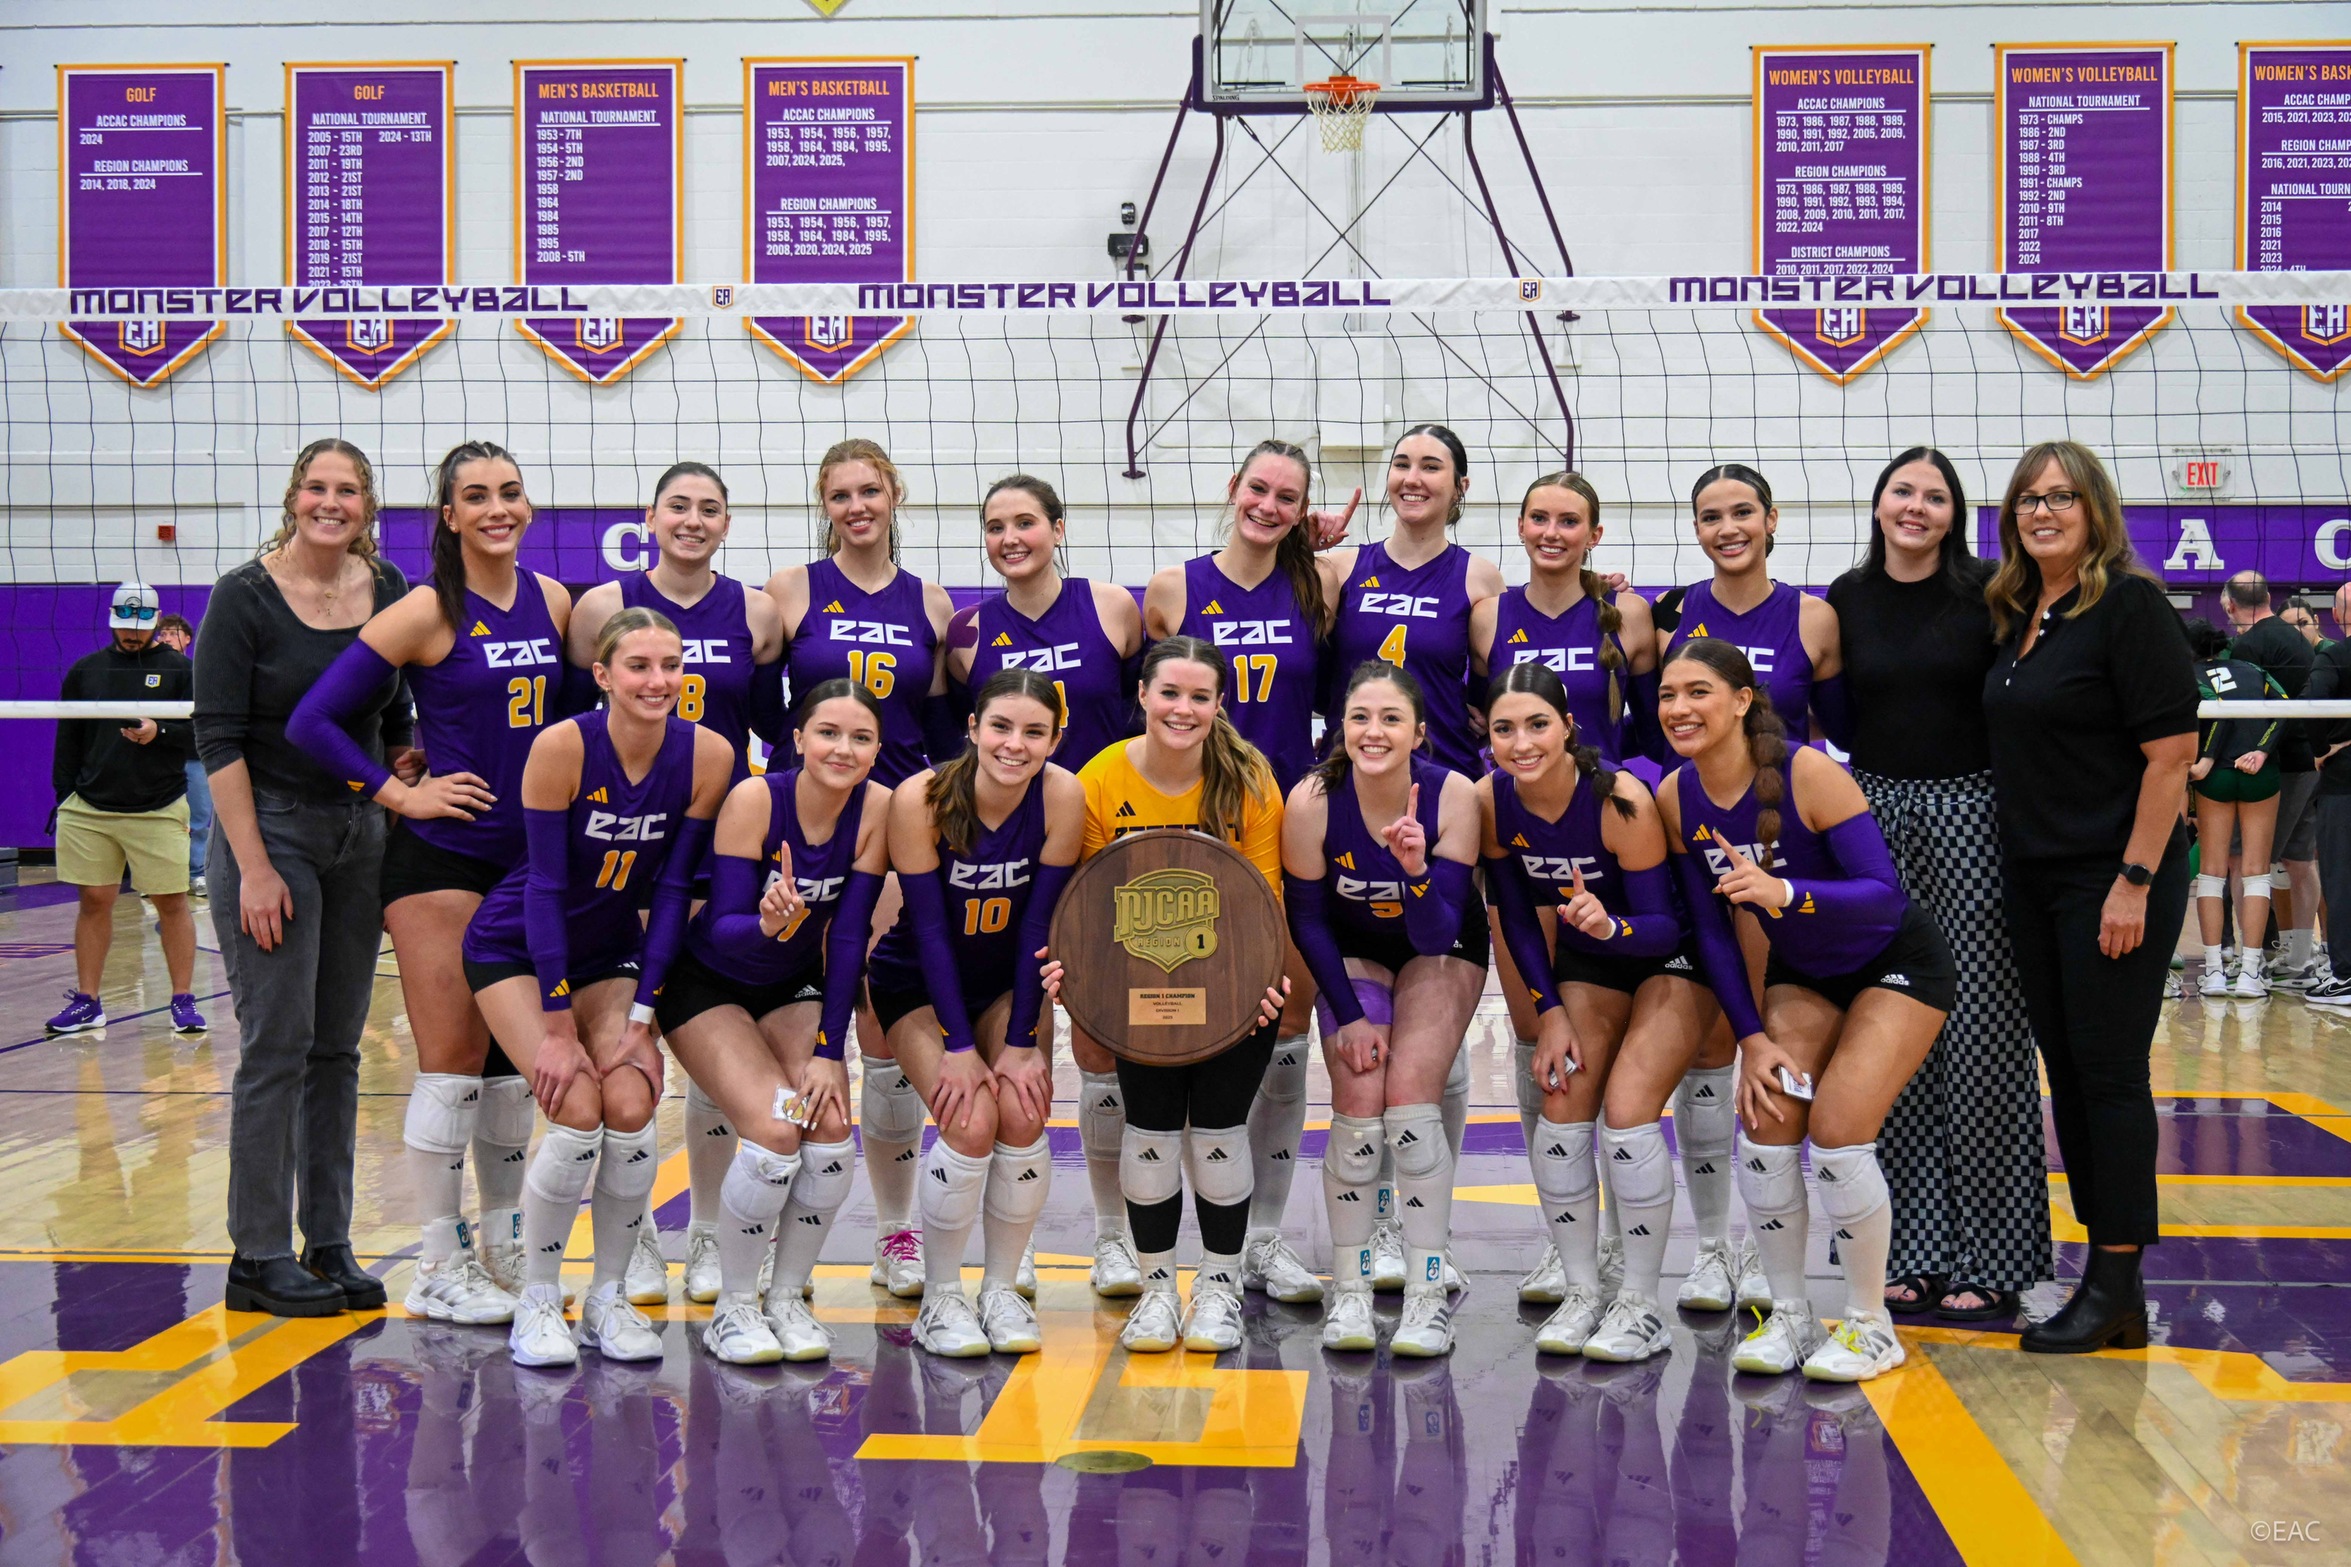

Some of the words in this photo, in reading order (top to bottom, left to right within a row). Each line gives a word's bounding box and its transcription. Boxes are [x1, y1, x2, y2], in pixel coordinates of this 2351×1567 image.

[1769, 70, 1830, 85] WOMEN'S
[1835, 69, 1914, 84] VOLLEYBALL
[2012, 68, 2073, 82] WOMEN'S
[2078, 67, 2158, 81] VOLLEYBALL
[2255, 66, 2317, 80] WOMEN'S
[354, 86, 385, 100] GOLF
[539, 84, 578, 98] MEN'S
[582, 83, 659, 98] BASKETBALL
[769, 81, 808, 96] MEN'S
[812, 80, 890, 95] BASKETBALL
[127, 88, 156, 102] GOLF
[2029, 96, 2074, 107] NATIONAL
[2076, 95, 2141, 106] TOURNAMENT
[2284, 94, 2315, 105] ACCAC
[1797, 98, 1828, 110] ACCAC
[1830, 97, 1885, 109] CHAMPIONS
[96, 115, 128, 127] ACCAC
[130, 115, 186, 126] CHAMPIONS
[312, 113, 359, 125] NATIONAL
[361, 112, 427, 124] TOURNAMENT
[541, 111, 588, 123] NATIONAL
[590, 110, 656, 123] TOURNAMENT
[783, 108, 815, 121] ACCAC
[817, 108, 875, 121] CHAMPIONS
[1776, 116, 1799, 127] 1973,
[1802, 116, 1826, 127] 1986,
[1830, 116, 1851, 127] 1987,
[1855, 115, 1878, 126] 1988,
[1882, 115, 1906, 126] 1989,
[2262, 112, 2286, 124] 2015,
[2287, 112, 2310, 123] 2021,
[2312, 112, 2337, 123] 2023,
[80, 134, 103, 144] 2024
[308, 131, 331, 142] 2005
[341, 131, 362, 142] 15TH
[379, 131, 402, 142] 2024
[410, 130, 432, 142] 13TH
[766, 127, 793, 140] 1953,
[799, 127, 827, 140] 1954,
[832, 127, 860, 139] 1956,
[865, 126, 891, 139] 1957,
[1776, 128, 1800, 140] 1990,
[1802, 128, 1824, 140] 1991,
[1827, 128, 1850, 140] 1992,
[1853, 128, 1878, 139] 2005,
[1880, 128, 1906, 139] 2009,
[766, 141, 793, 153] 1958,
[799, 140, 826, 153] 1964,
[831, 140, 858, 153] 1984,
[864, 140, 891, 153] 1995,
[1776, 141, 1800, 153] 2010,
[1801, 141, 1823, 152] 2011,
[1824, 141, 1844, 152] 2017
[2281, 140, 2316, 151] REGION
[94, 160, 129, 172] REGION
[132, 160, 188, 172] CHAMPIONS
[766, 154, 791, 167] 2007,
[792, 154, 818, 167] 2024,
[819, 154, 846, 167] 2025,
[2262, 158, 2285, 169] 2016,
[2287, 158, 2310, 169] 2021,
[2311, 157, 2336, 169] 2023,
[1795, 166, 1829, 177] REGION
[1831, 165, 1887, 177] CHAMPIONS
[80, 179, 105, 191] 2014,
[107, 179, 131, 190] 2018,
[133, 178, 156, 190] 2024
[537, 183, 559, 195] 1958
[2271, 184, 2317, 195] NATIONAL
[537, 197, 559, 208] 1964
[780, 198, 817, 210] REGION
[819, 197, 877, 210] CHAMPIONS
[2261, 201, 2282, 212] 2014
[537, 210, 559, 222] 1984
[2261, 214, 2282, 225] 2015
[537, 224, 559, 235] 1985
[2018, 228, 2039, 239] 2017
[2261, 227, 2282, 238] 2016
[537, 237, 559, 249] 1995
[2018, 241, 2040, 252] 2022
[2260, 240, 2281, 250] 2021
[1791, 246, 1833, 258] DISTRICT
[1835, 246, 1890, 258] CHAMPIONS
[2260, 252, 2282, 263] 2023
[2018, 254, 2040, 264] 2024
[2187, 462, 2218, 486] EXIT
[602, 522, 649, 572] C
[2163, 519, 2224, 570] A
[682, 640, 731, 663] ac
[1377, 624, 1407, 669] 4
[847, 650, 895, 699] 16
[1233, 654, 1276, 703] 17
[2206, 667, 2237, 693] 2
[506, 675, 546, 727] 21
[677, 674, 706, 722] 8
[595, 850, 637, 890] 11
[1336, 875, 1405, 900] ea
[964, 898, 1010, 934] 10
[1120, 891, 1215, 935] NJCAA
[1137, 938, 1181, 948] REGION
[1196, 934, 1204, 949] 1
